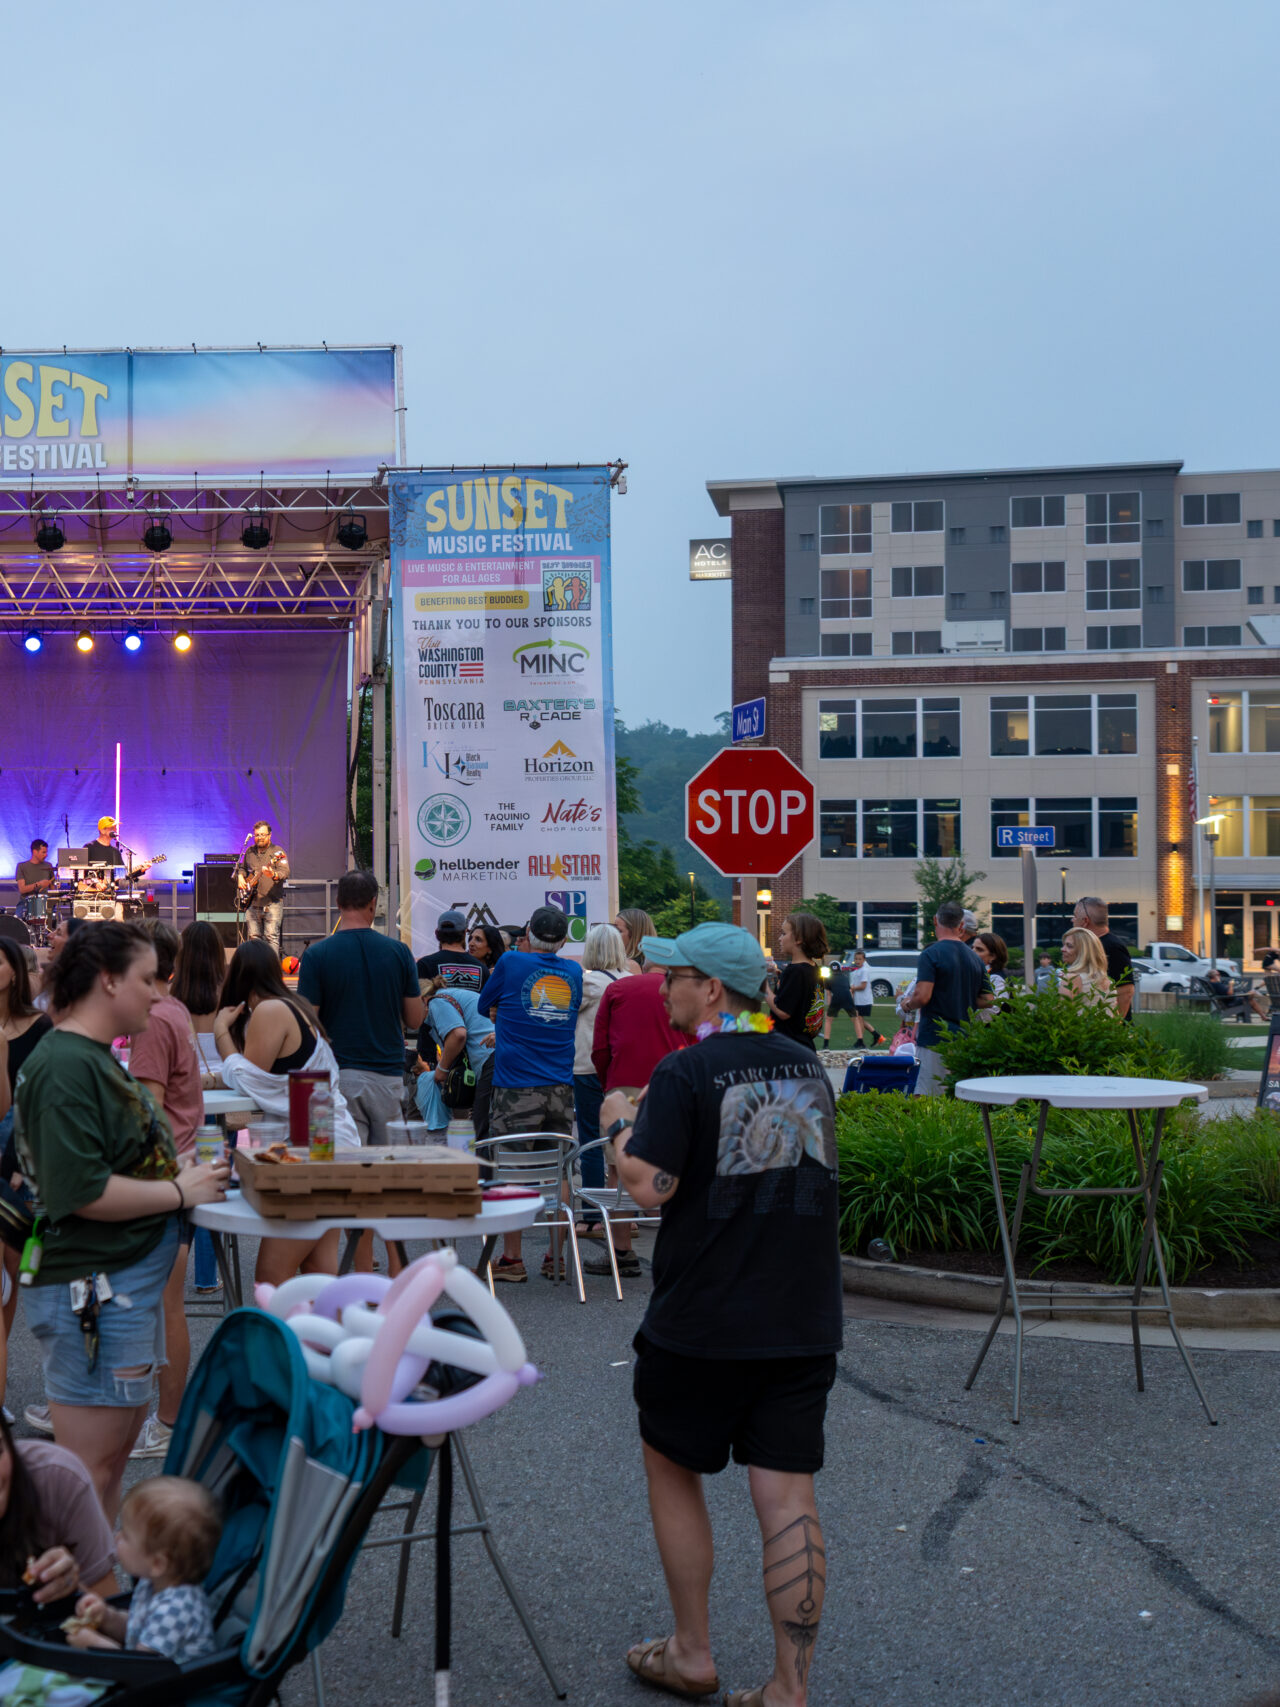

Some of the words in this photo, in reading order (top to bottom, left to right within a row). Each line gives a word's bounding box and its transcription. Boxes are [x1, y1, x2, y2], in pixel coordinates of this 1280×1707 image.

[426, 476, 574, 532] SUNSET
[428, 536, 486, 554] MUSIC
[492, 533, 573, 552] FESTIVAL
[695, 543, 726, 560] AC
[408, 564, 425, 573] LIVE
[428, 563, 456, 572] MUSIC
[458, 563, 463, 572] &
[465, 561, 535, 572] ENTERTAINMENT
[442, 574, 460, 584] FOR
[462, 574, 478, 583] ALL
[478, 574, 500, 583] AGES
[420, 597, 466, 606] BENEFITING
[468, 596, 488, 606] BEST
[489, 596, 524, 604] BUDDIES
[412, 620, 451, 630] THANK
[456, 619, 480, 630] YOU
[485, 618, 500, 629] TO
[506, 618, 529, 628] OUR
[534, 616, 592, 628] SPONSORS
[418, 647, 484, 662] WASHINGTON
[418, 663, 457, 678] COUNTY
[520, 653, 585, 674] MINC
[424, 698, 485, 722] Toscana
[504, 698, 596, 712] BAXTER'S
[428, 722, 455, 730] BRICK
[462, 721, 485, 729] OVEN
[736, 710, 752, 736] Main
[752, 707, 760, 731] St
[524, 758, 594, 773] Horizon
[498, 802, 516, 810] THE
[540, 798, 602, 824] Nate's
[696, 788, 806, 835] STOP
[484, 812, 530, 822] TAQUINIO
[490, 824, 524, 832] FAMILY
[1002, 830, 1013, 844] R
[1017, 832, 1050, 842] Street
[440, 858, 520, 870] hellbender
[528, 855, 554, 876] ALL
[562, 854, 601, 876] STAR
[442, 871, 518, 882] MARKETING
